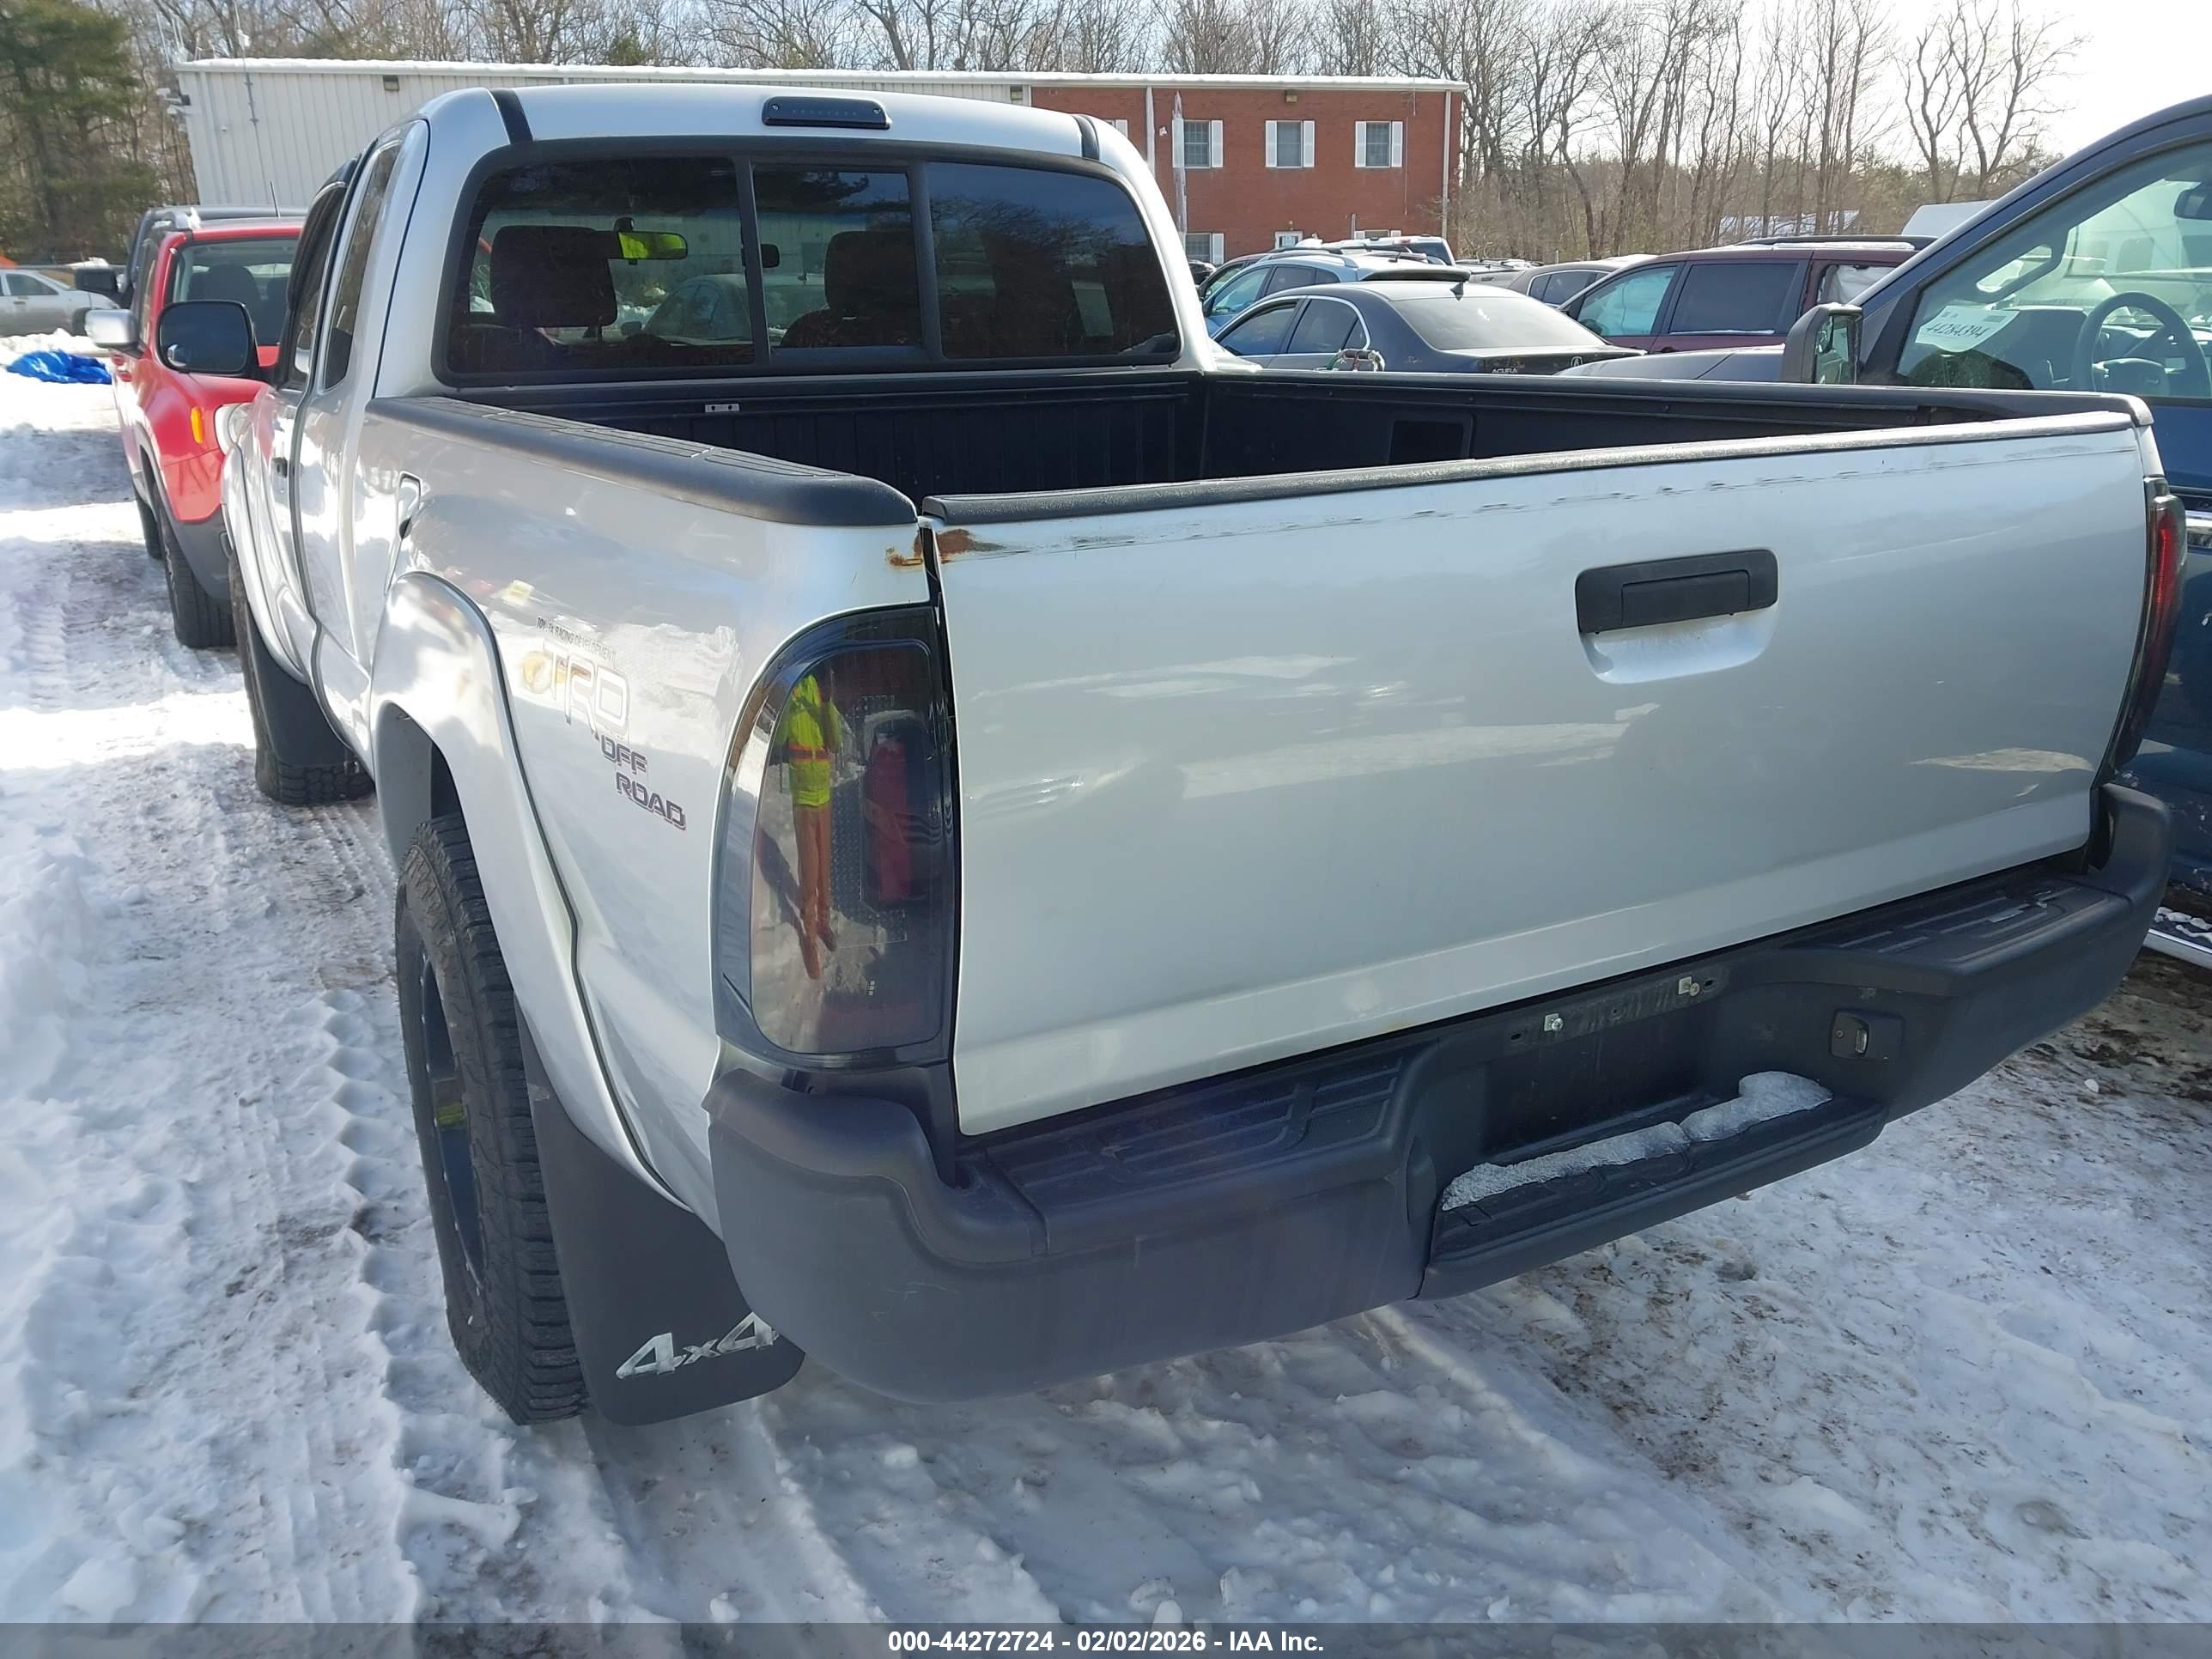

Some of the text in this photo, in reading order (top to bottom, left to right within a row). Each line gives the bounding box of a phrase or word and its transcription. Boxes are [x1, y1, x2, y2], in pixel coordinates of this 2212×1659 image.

[544, 641, 630, 740] TRD
[601, 735, 647, 775] OFF
[617, 775, 687, 830] ROAD
[616, 1312, 780, 1380] 4x4
